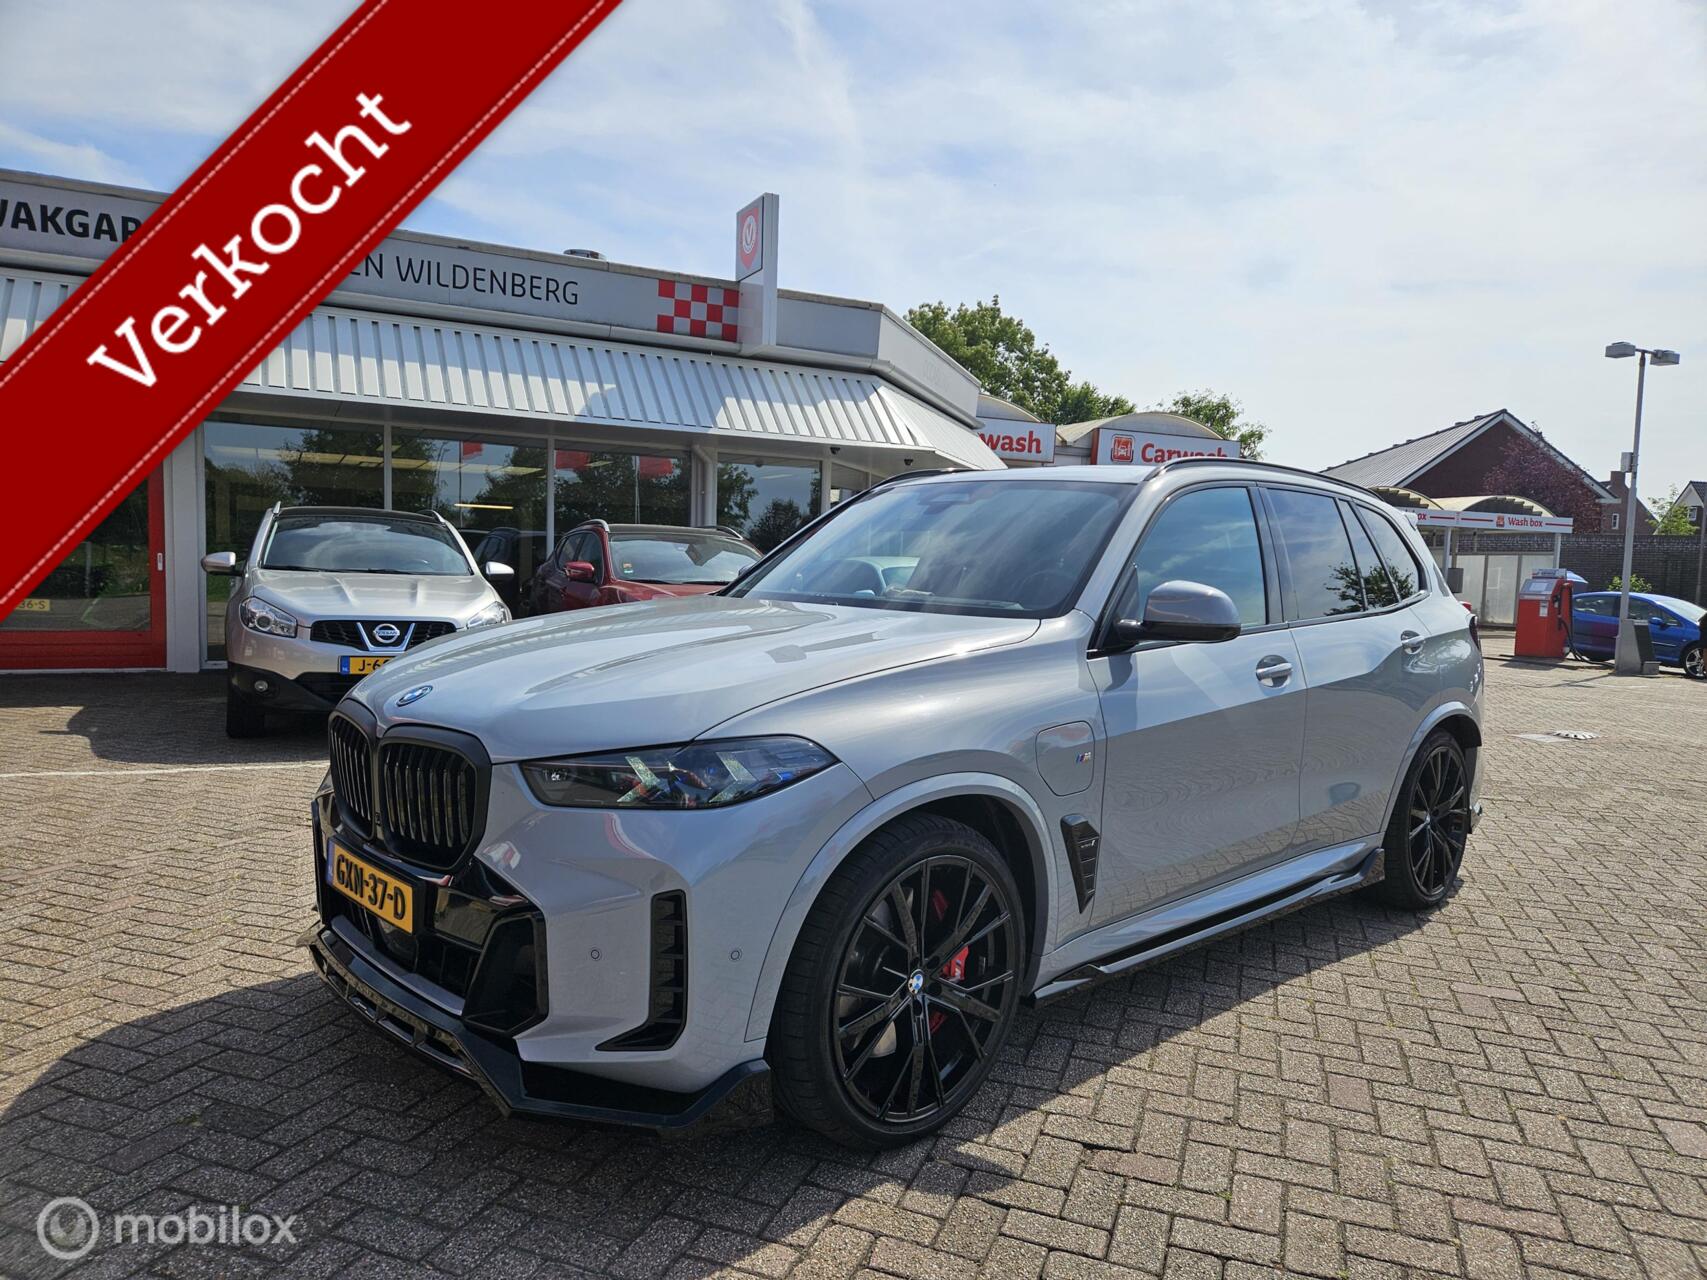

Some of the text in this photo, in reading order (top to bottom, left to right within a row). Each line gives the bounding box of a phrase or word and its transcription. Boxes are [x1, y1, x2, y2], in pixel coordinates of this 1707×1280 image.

[396, 255, 578, 305] WILDENBERG
[1508, 517, 1543, 527] Wash box
[337, 854, 406, 920] GXN-37-D
